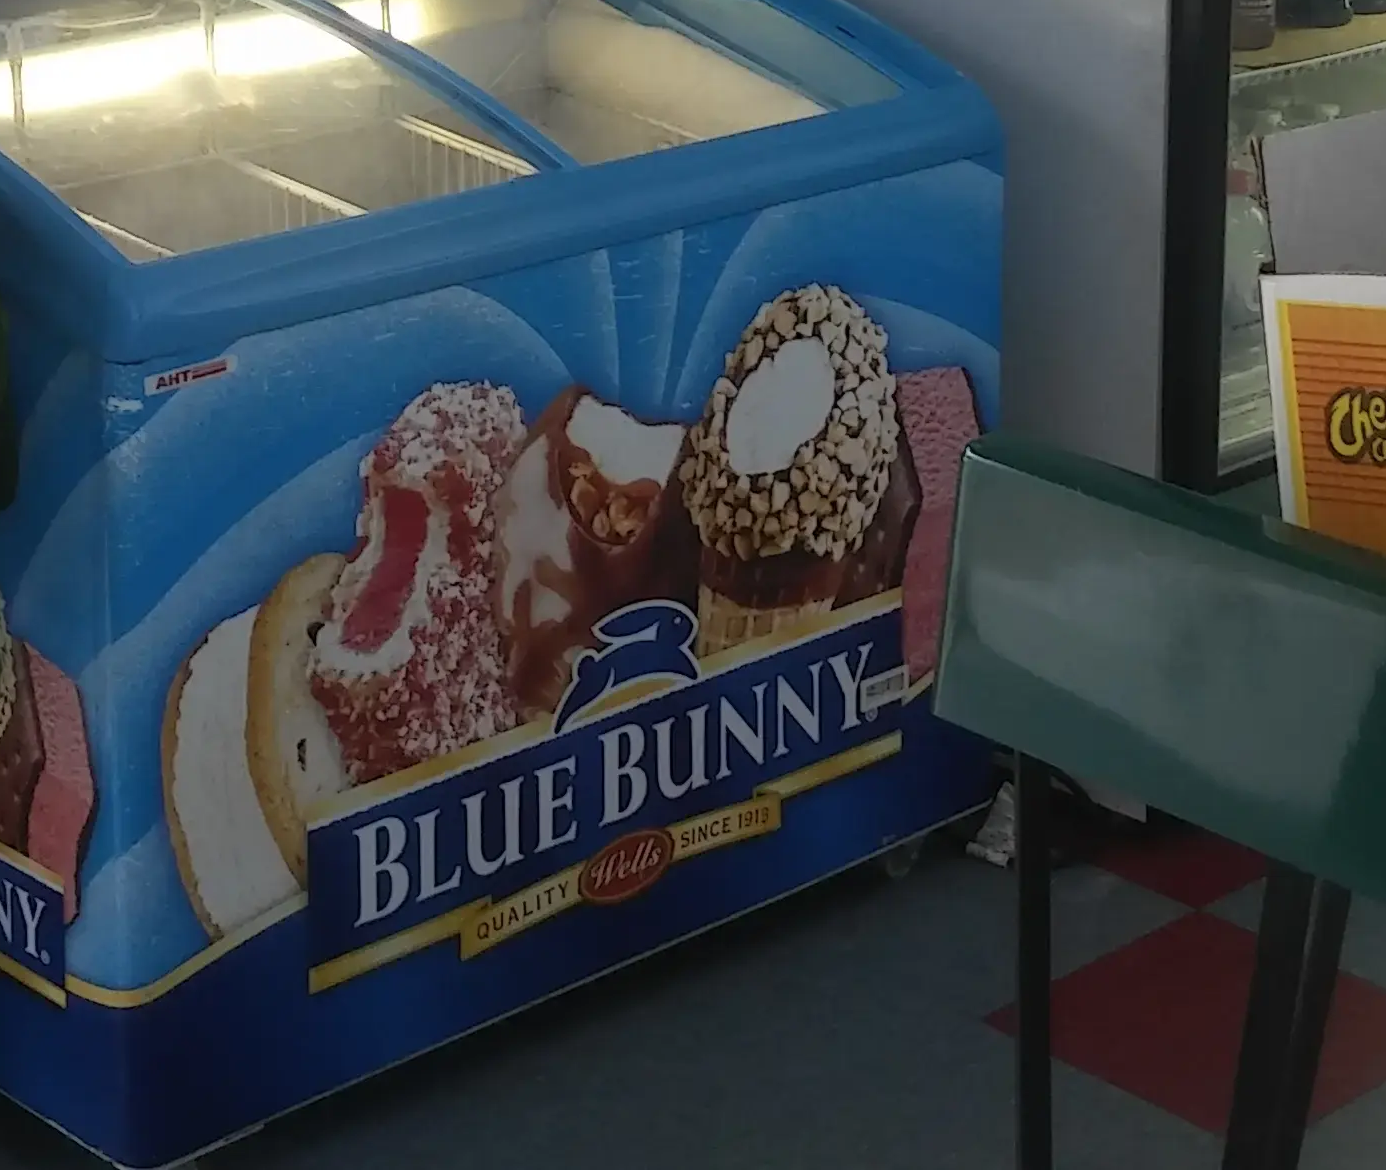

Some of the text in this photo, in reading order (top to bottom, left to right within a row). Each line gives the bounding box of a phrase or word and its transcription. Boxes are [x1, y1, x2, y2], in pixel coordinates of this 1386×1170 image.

[155, 369, 192, 391] AHT
[352, 640, 876, 931] BLUE BUNNY
[475, 804, 771, 941] QUALITY Wells SINCE 1913
